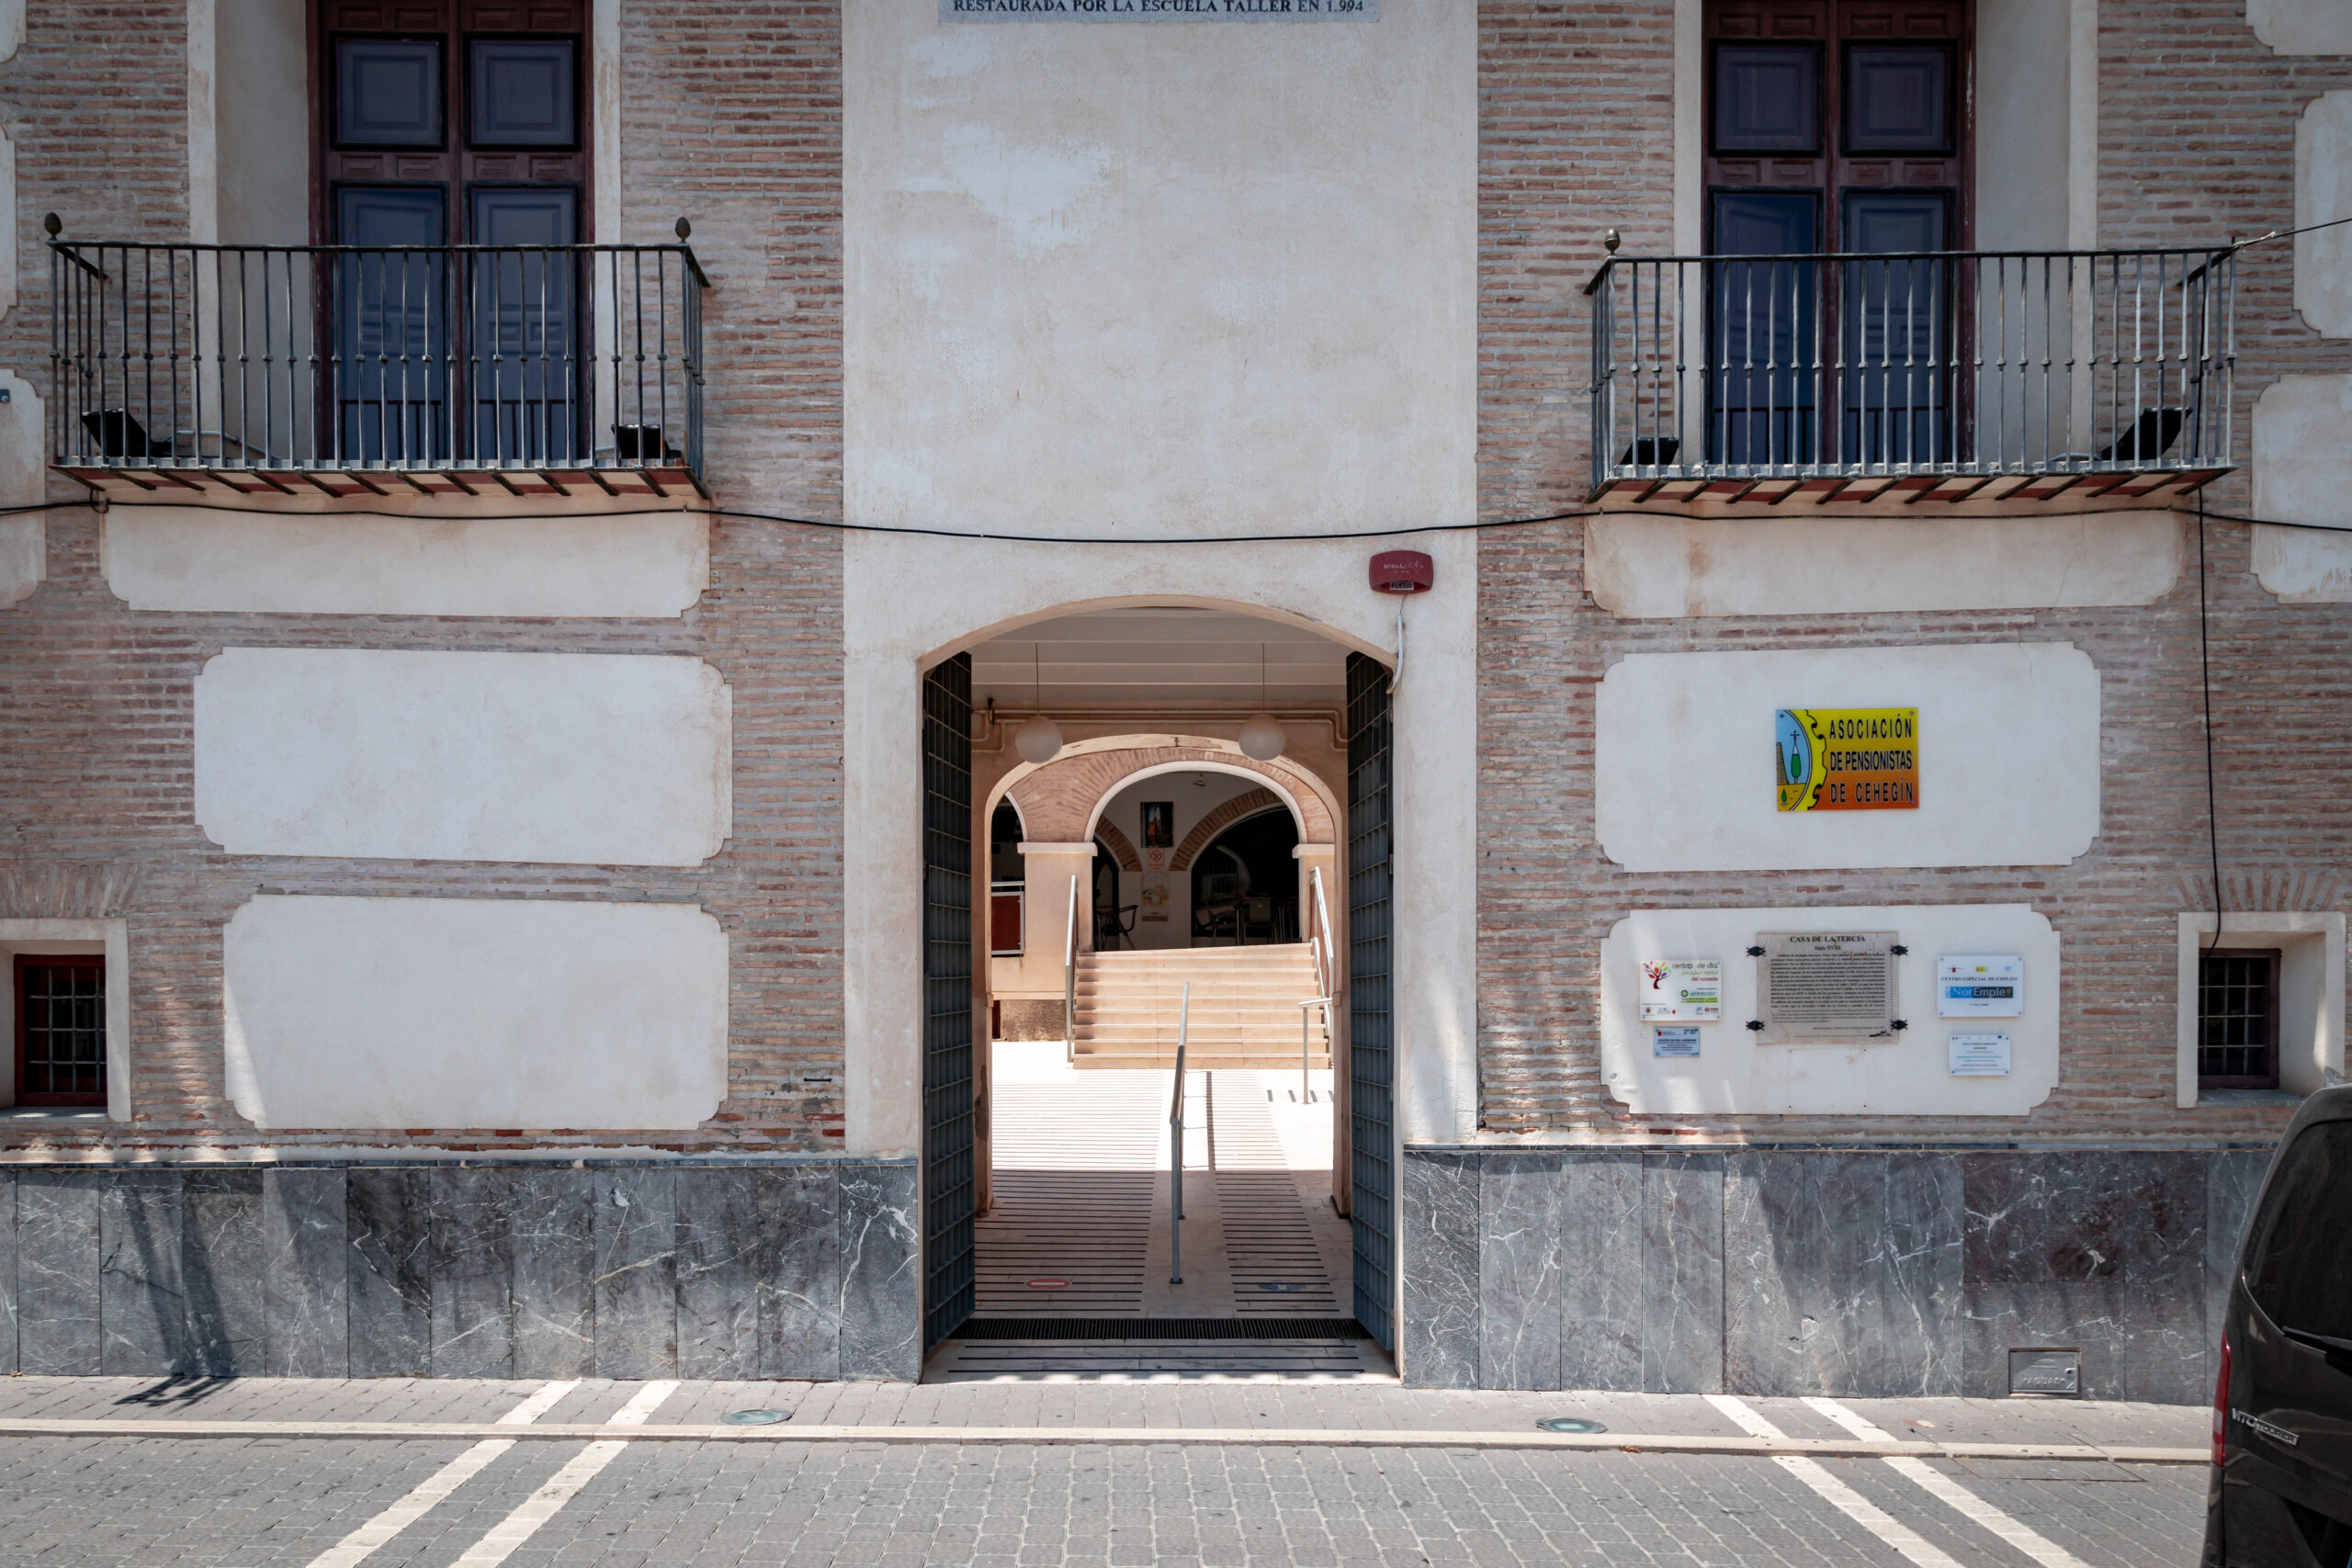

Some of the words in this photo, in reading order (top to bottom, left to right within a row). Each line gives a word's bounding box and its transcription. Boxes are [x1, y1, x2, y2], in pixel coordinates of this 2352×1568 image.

[954, 0, 1067, 12] RESTAURADA
[1072, 0, 1107, 12] POR
[1113, 0, 1134, 12] LA
[1141, 0, 1217, 12] ESCUELA
[1225, 0, 1292, 12] TALLER
[1297, 0, 1319, 12] EN
[1327, 0, 1363, 12] 1.994
[1829, 713, 1912, 739] ASOCIACIÓN
[1830, 751, 1843, 771] DE
[1845, 750, 1912, 771] PENSIONISTAS
[1830, 783, 1846, 803] DE
[1856, 776, 1913, 803] CEHEGÍN
